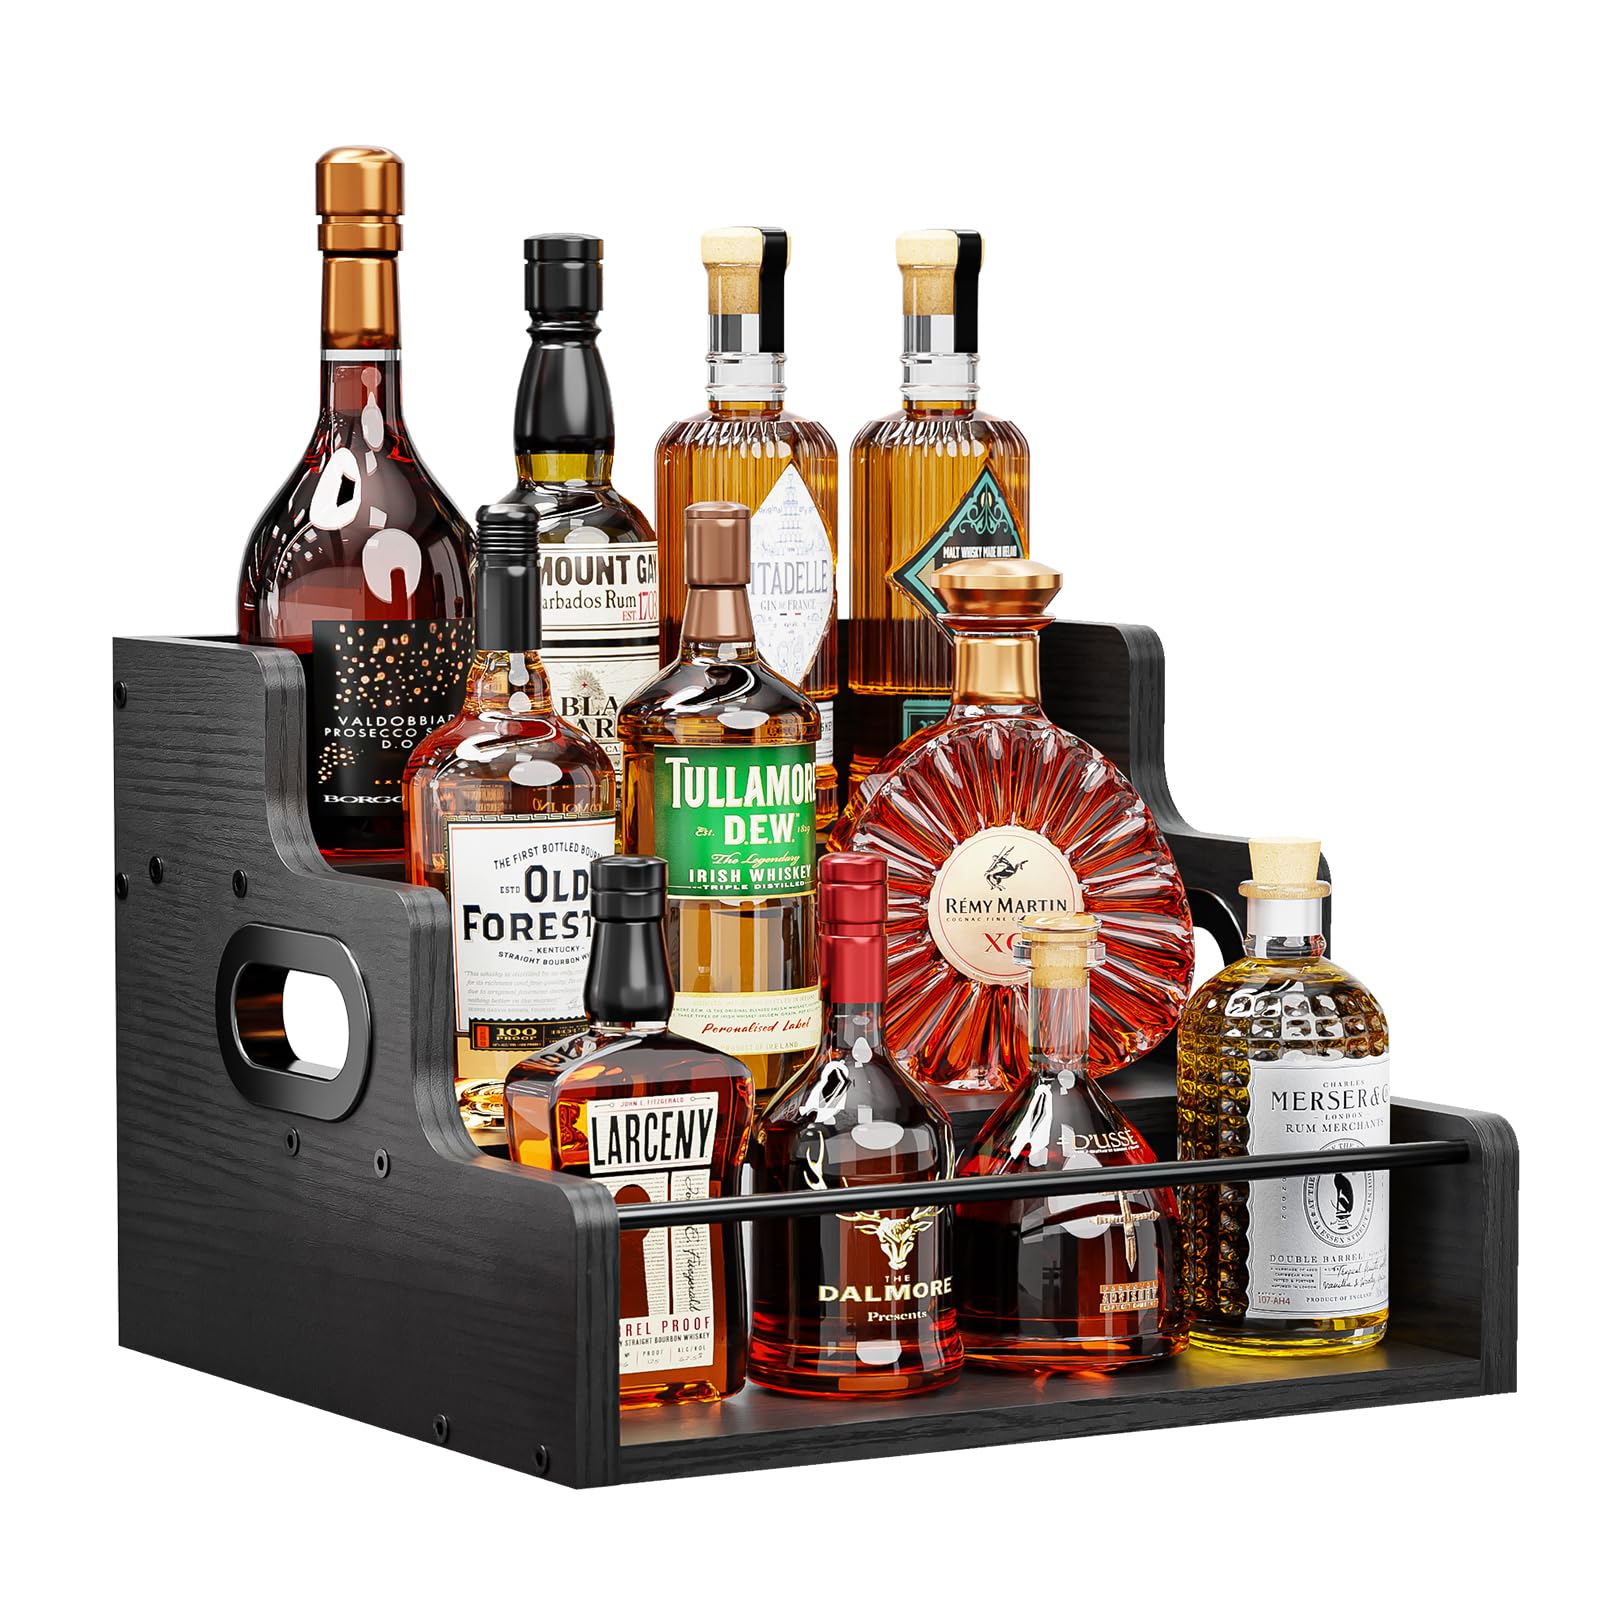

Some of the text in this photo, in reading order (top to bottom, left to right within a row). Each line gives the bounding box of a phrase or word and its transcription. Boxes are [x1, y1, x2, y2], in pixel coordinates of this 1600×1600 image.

[943, 546, 960, 558] MALT
[605, 589, 636, 608] Rum
[760, 600, 777, 611] GIN
[325, 728, 418, 738] PROSECCO
[494, 856, 511, 870] THE
[514, 846, 539, 864] FIRST
[543, 842, 579, 853] BOTTLED
[711, 851, 801, 868] The Legendary
[689, 864, 812, 883] IRISH WHISKEY
[500, 865, 590, 903] ESTD OLD
[754, 881, 806, 889] DISTILLED
[946, 897, 1067, 914] RÉMY MARTIN
[536, 945, 580, 954] KENTUCKY
[498, 951, 540, 965] STRAIGHT
[542, 956, 580, 966] BOURBON
[782, 1017, 812, 1031] Label
[496, 1027, 537, 1037] 100
[647, 1097, 684, 1105] FITZGERALD
[1325, 1112, 1363, 1120] LONDON
[1286, 1123, 1316, 1133] RUM
[592, 1108, 713, 1166] LARCENY
[1270, 1253, 1363, 1263] DOUBLE BARREL
[884, 1275, 911, 1283] THE
[818, 1276, 953, 1302] DALMORE
[867, 1311, 927, 1322] Presents
[661, 1316, 711, 1333] PROOF
[625, 1338, 653, 1347] STRAIGHT
[654, 1336, 682, 1344] BOURBON
[683, 1332, 710, 1340] WHISKEY
